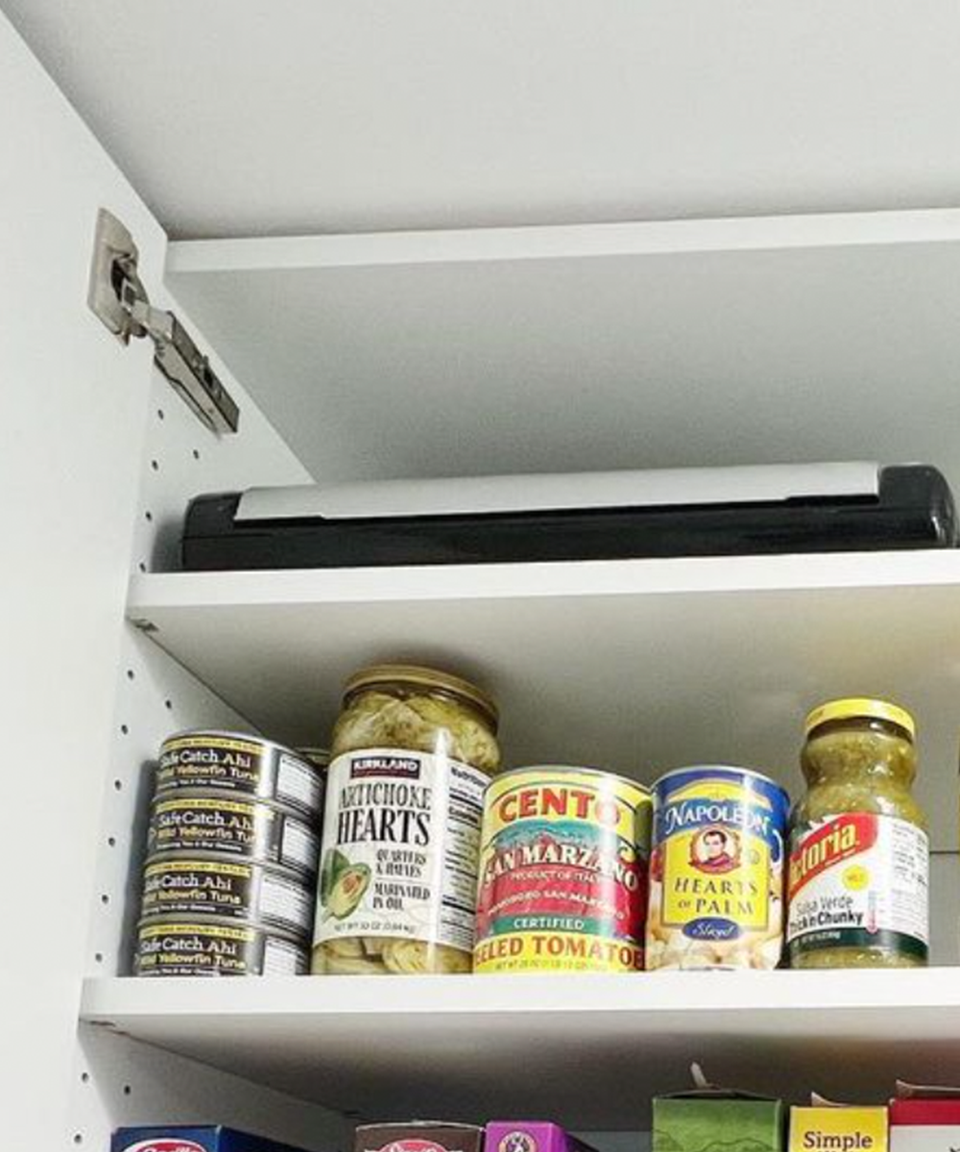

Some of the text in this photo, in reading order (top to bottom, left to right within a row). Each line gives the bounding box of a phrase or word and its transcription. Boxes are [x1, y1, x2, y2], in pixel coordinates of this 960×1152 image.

[224, 752, 250, 768] Ahi
[353, 759, 418, 772] KIRKLAND
[338, 781, 432, 811] ARTICHOKE
[499, 787, 621, 826] CENTO
[664, 800, 771, 835] NAPOLEON
[336, 808, 431, 846] HEARTS
[484, 843, 638, 891] SAN MARZANO
[203, 876, 232, 892] Ahi
[374, 882, 431, 900] MARINATED
[674, 877, 759, 895] HEARTS
[372, 898, 404, 911] IN OIL
[695, 899, 754, 915] PALM
[513, 917, 585, 931] CERTIFIED
[207, 940, 237, 955] Ahi
[803, 1131, 873, 1151] Simple
